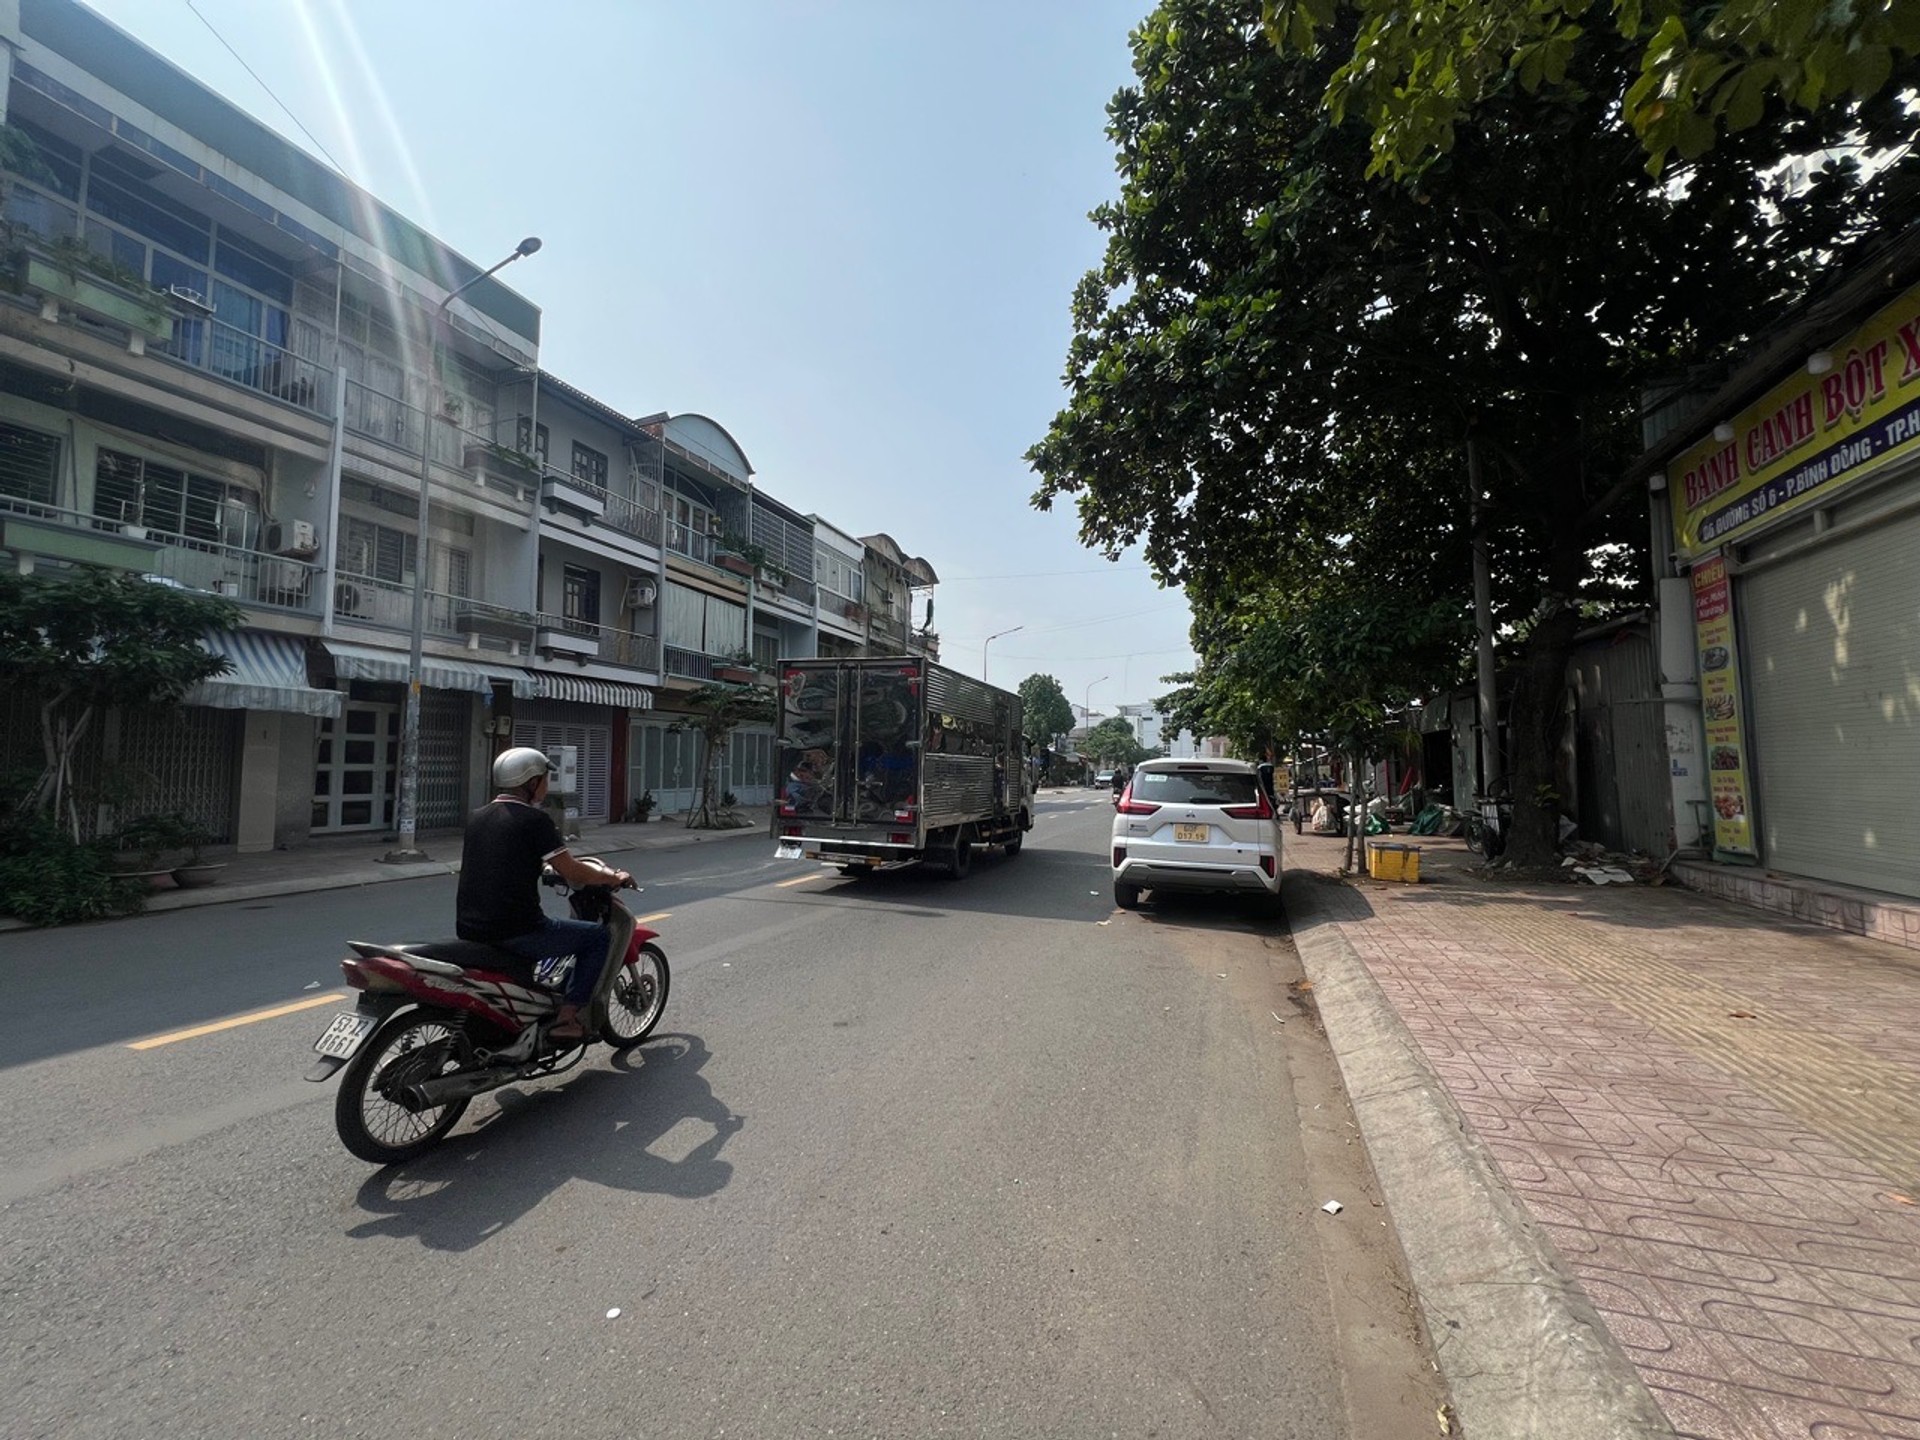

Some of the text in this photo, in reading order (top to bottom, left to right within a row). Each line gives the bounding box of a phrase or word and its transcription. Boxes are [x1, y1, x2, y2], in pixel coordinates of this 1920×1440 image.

[1746, 391, 1815, 472] CANH
[1821, 340, 1888, 429] BỘT
[1751, 488, 1767, 515] SỐ
[1768, 488, 1777, 507] 6
